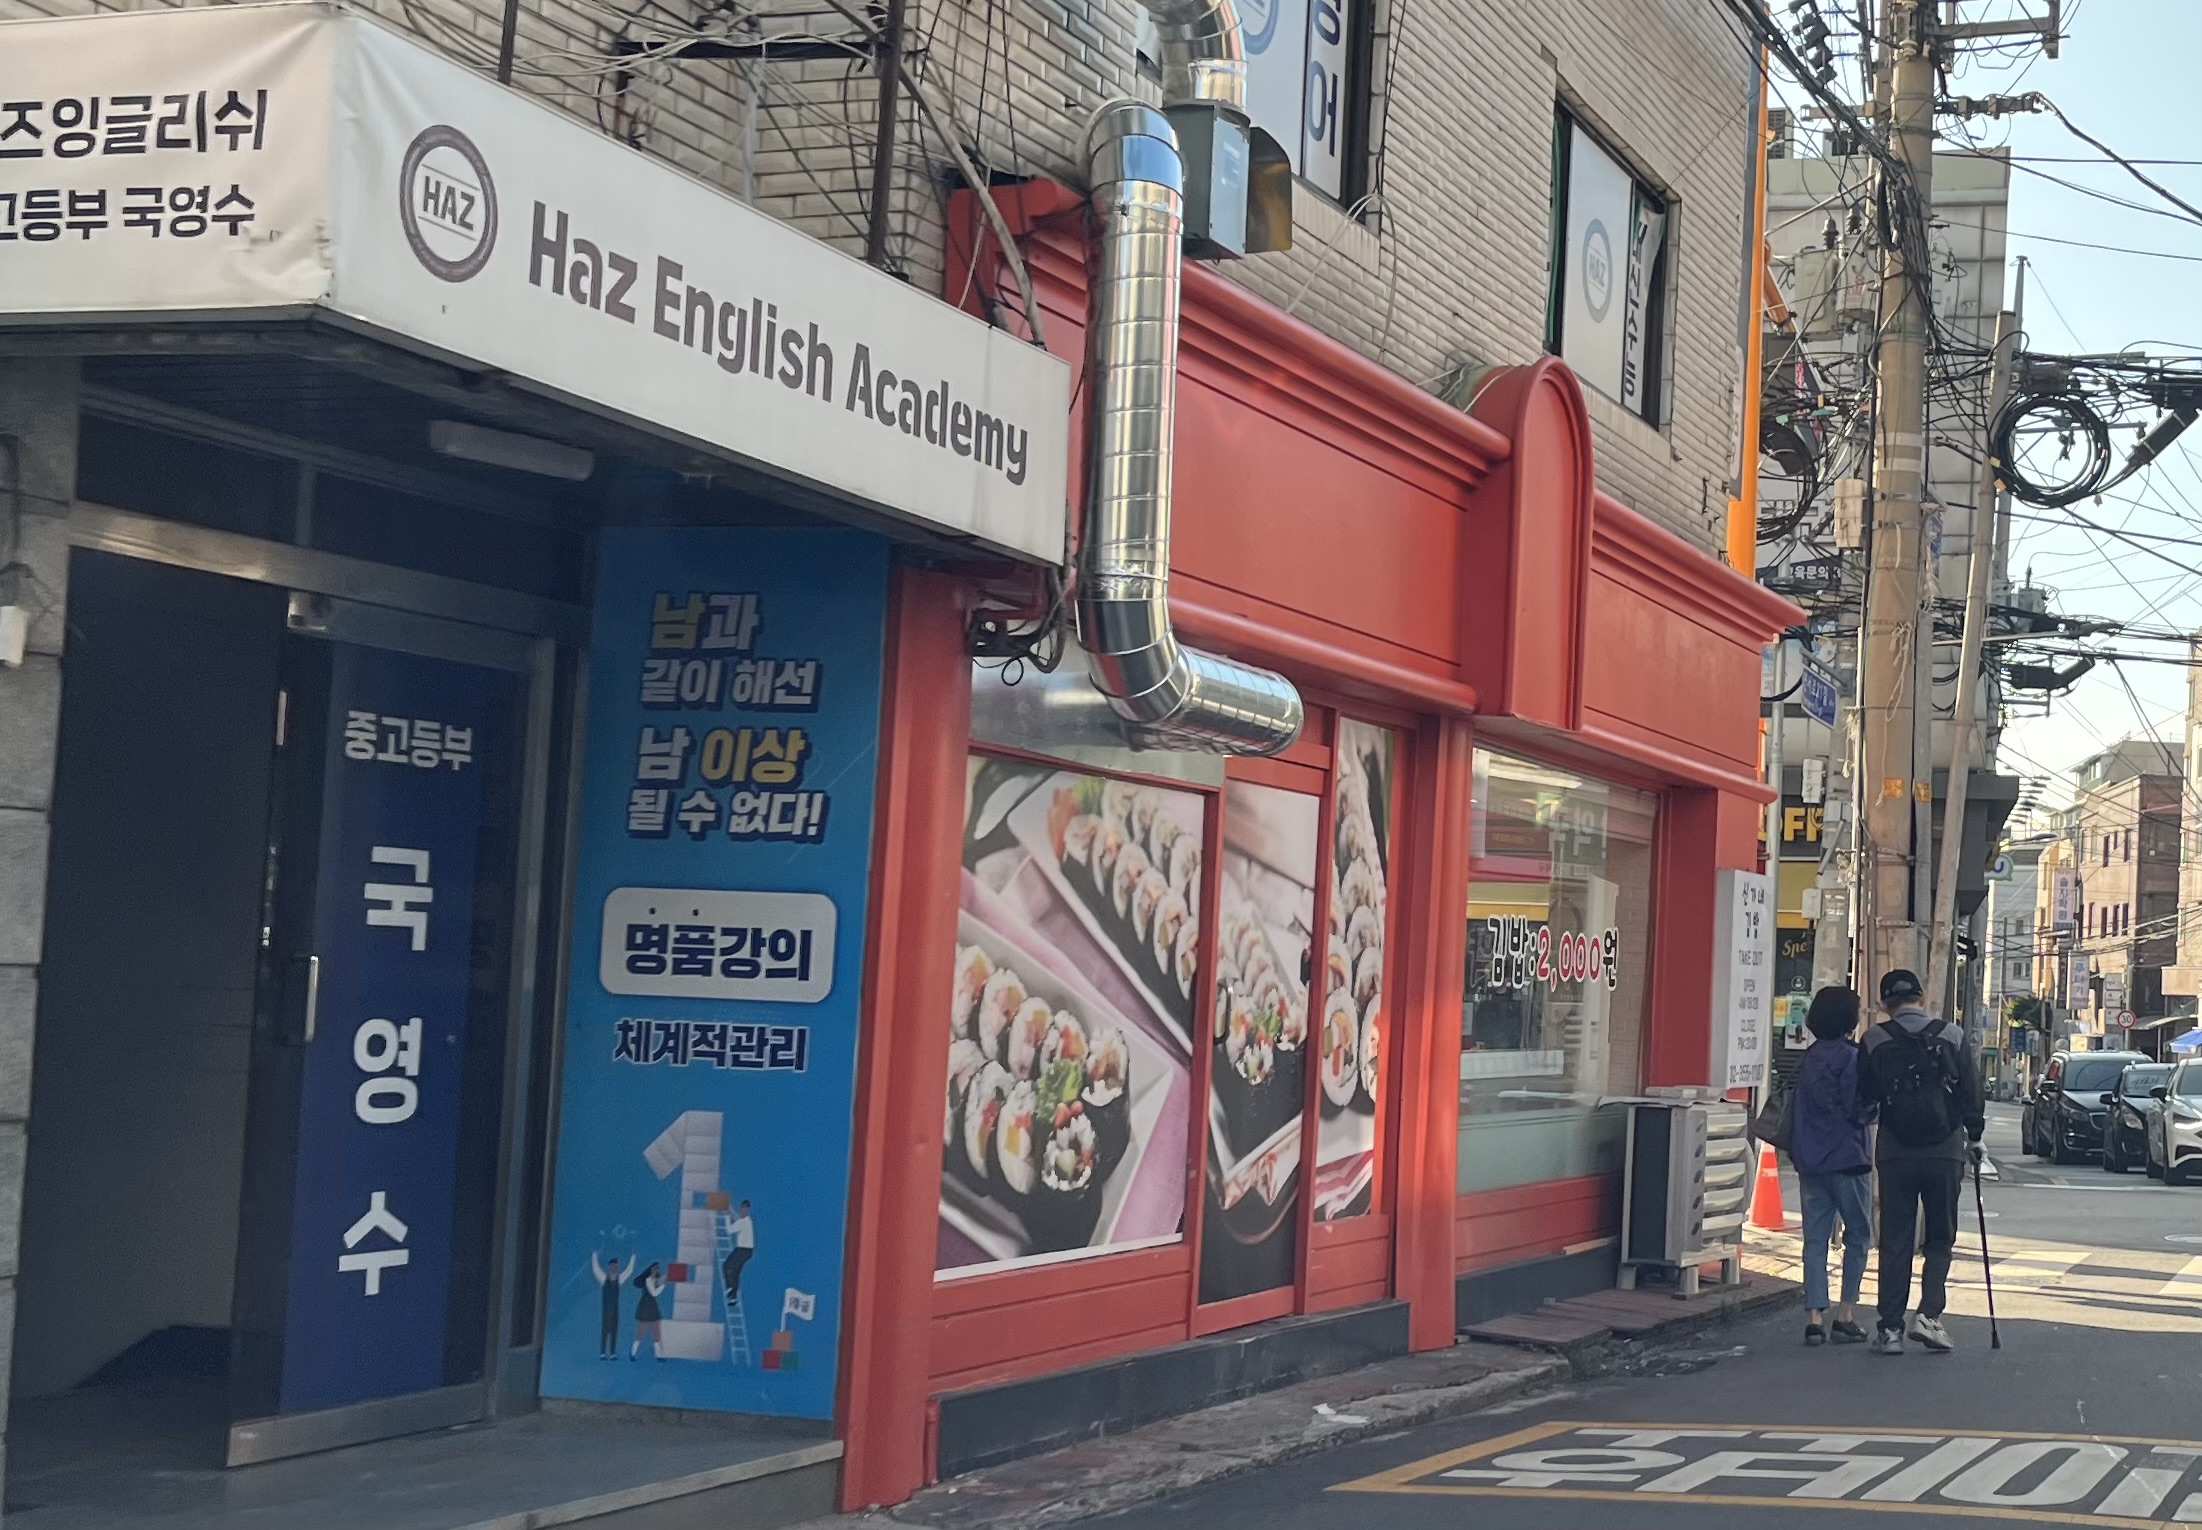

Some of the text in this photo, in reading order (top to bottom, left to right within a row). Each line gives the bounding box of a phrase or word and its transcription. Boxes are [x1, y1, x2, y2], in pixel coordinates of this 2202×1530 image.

[0, 89, 268, 158] 즈잉글리쉬
[122, 184, 255, 237] 국영수
[423, 176, 479, 231] HAZ
[1587, 249, 1607, 288] HAZ
[529, 200, 1028, 486] Haz English Academy
[650, 592, 760, 651] 남과
[640, 658, 818, 706] 같이 해선
[344, 709, 473, 771] 중고등부
[637, 727, 806, 784] 남 이상
[678, 790, 717, 833] 수
[728, 790, 827, 837] 없다!
[624, 922, 813, 982] 명품강의
[1745, 911, 1760, 939] 김밥
[612, 1017, 810, 1074] 체계적관리
[2121, 1015, 2132, 1024] 30
